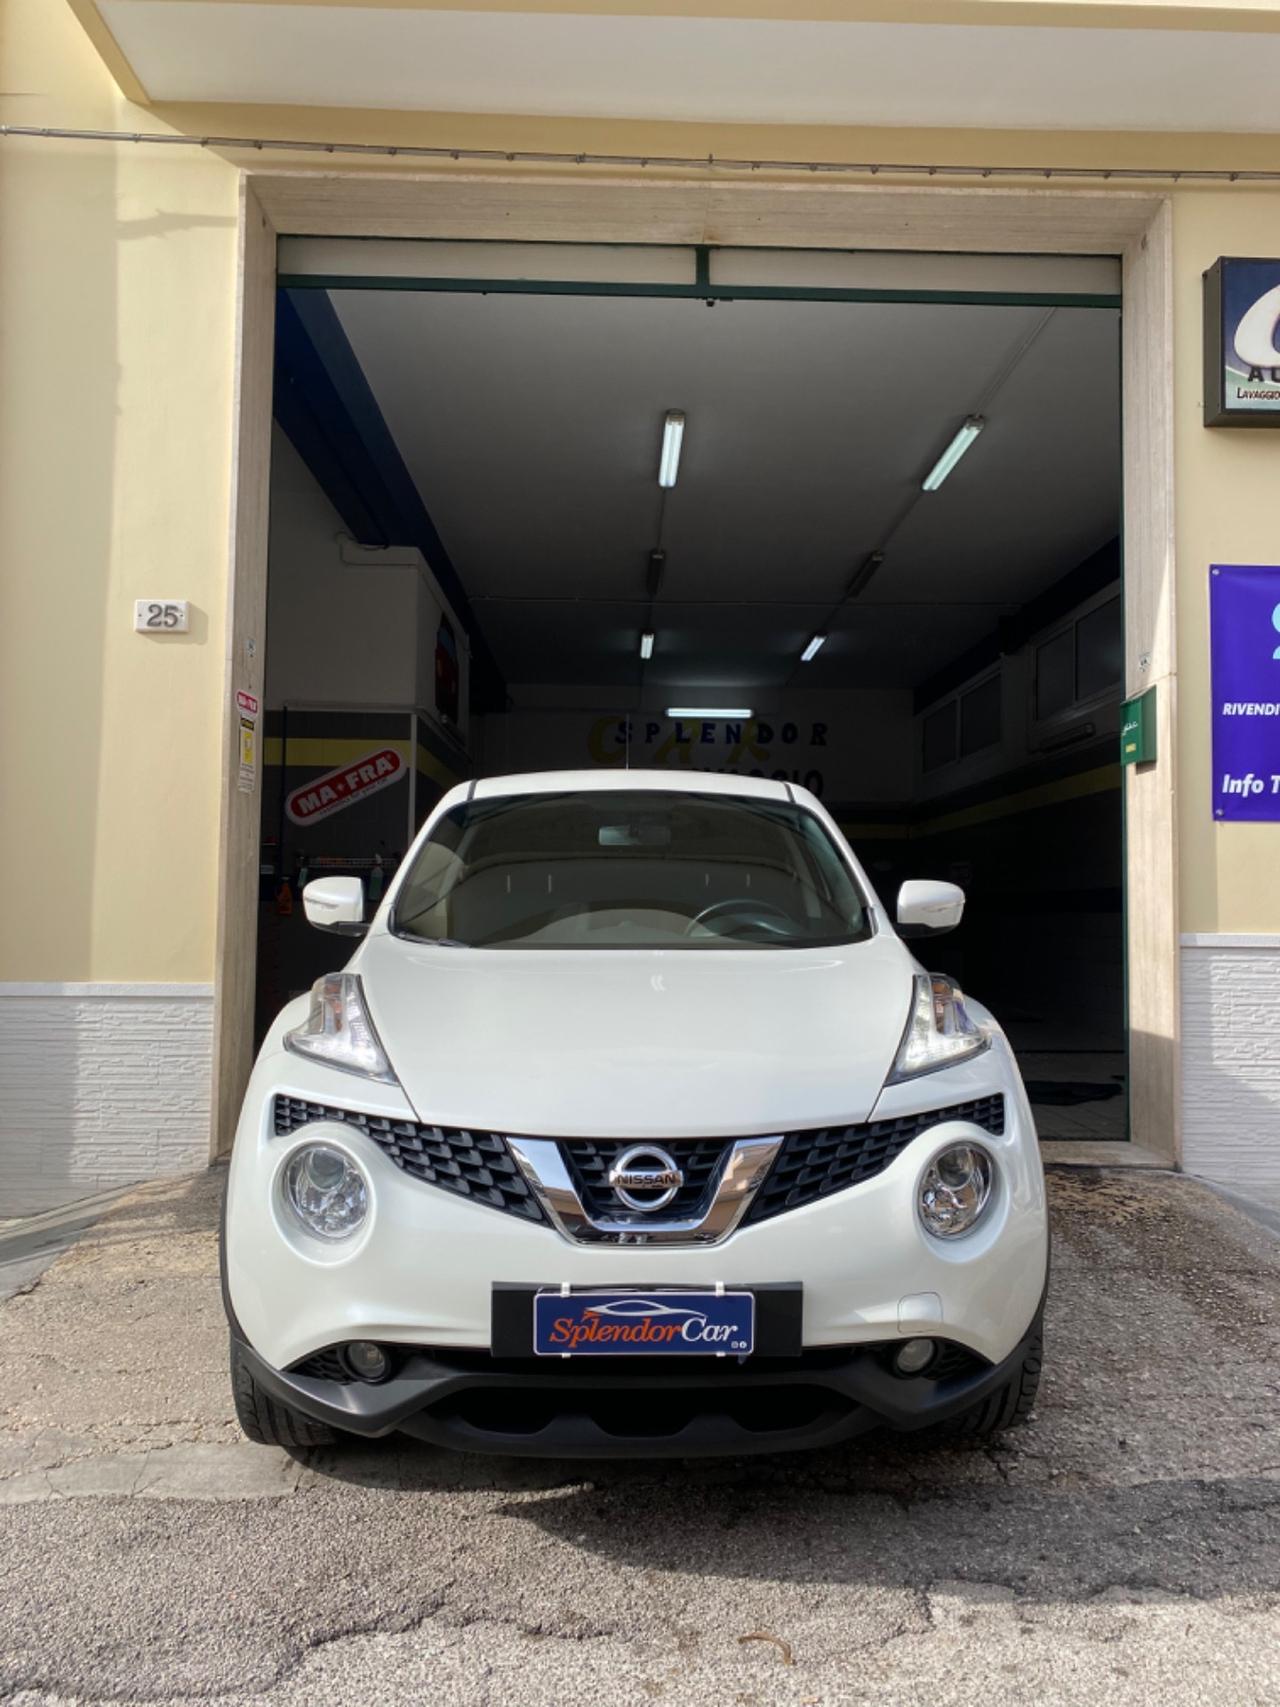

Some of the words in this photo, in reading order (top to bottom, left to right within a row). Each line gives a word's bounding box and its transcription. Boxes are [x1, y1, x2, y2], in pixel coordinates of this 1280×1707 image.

[147, 604, 178, 628] 25
[615, 722, 829, 746] SPLENDOR
[1222, 772, 1265, 798] Info
[616, 1173, 677, 1185] NISSAN
